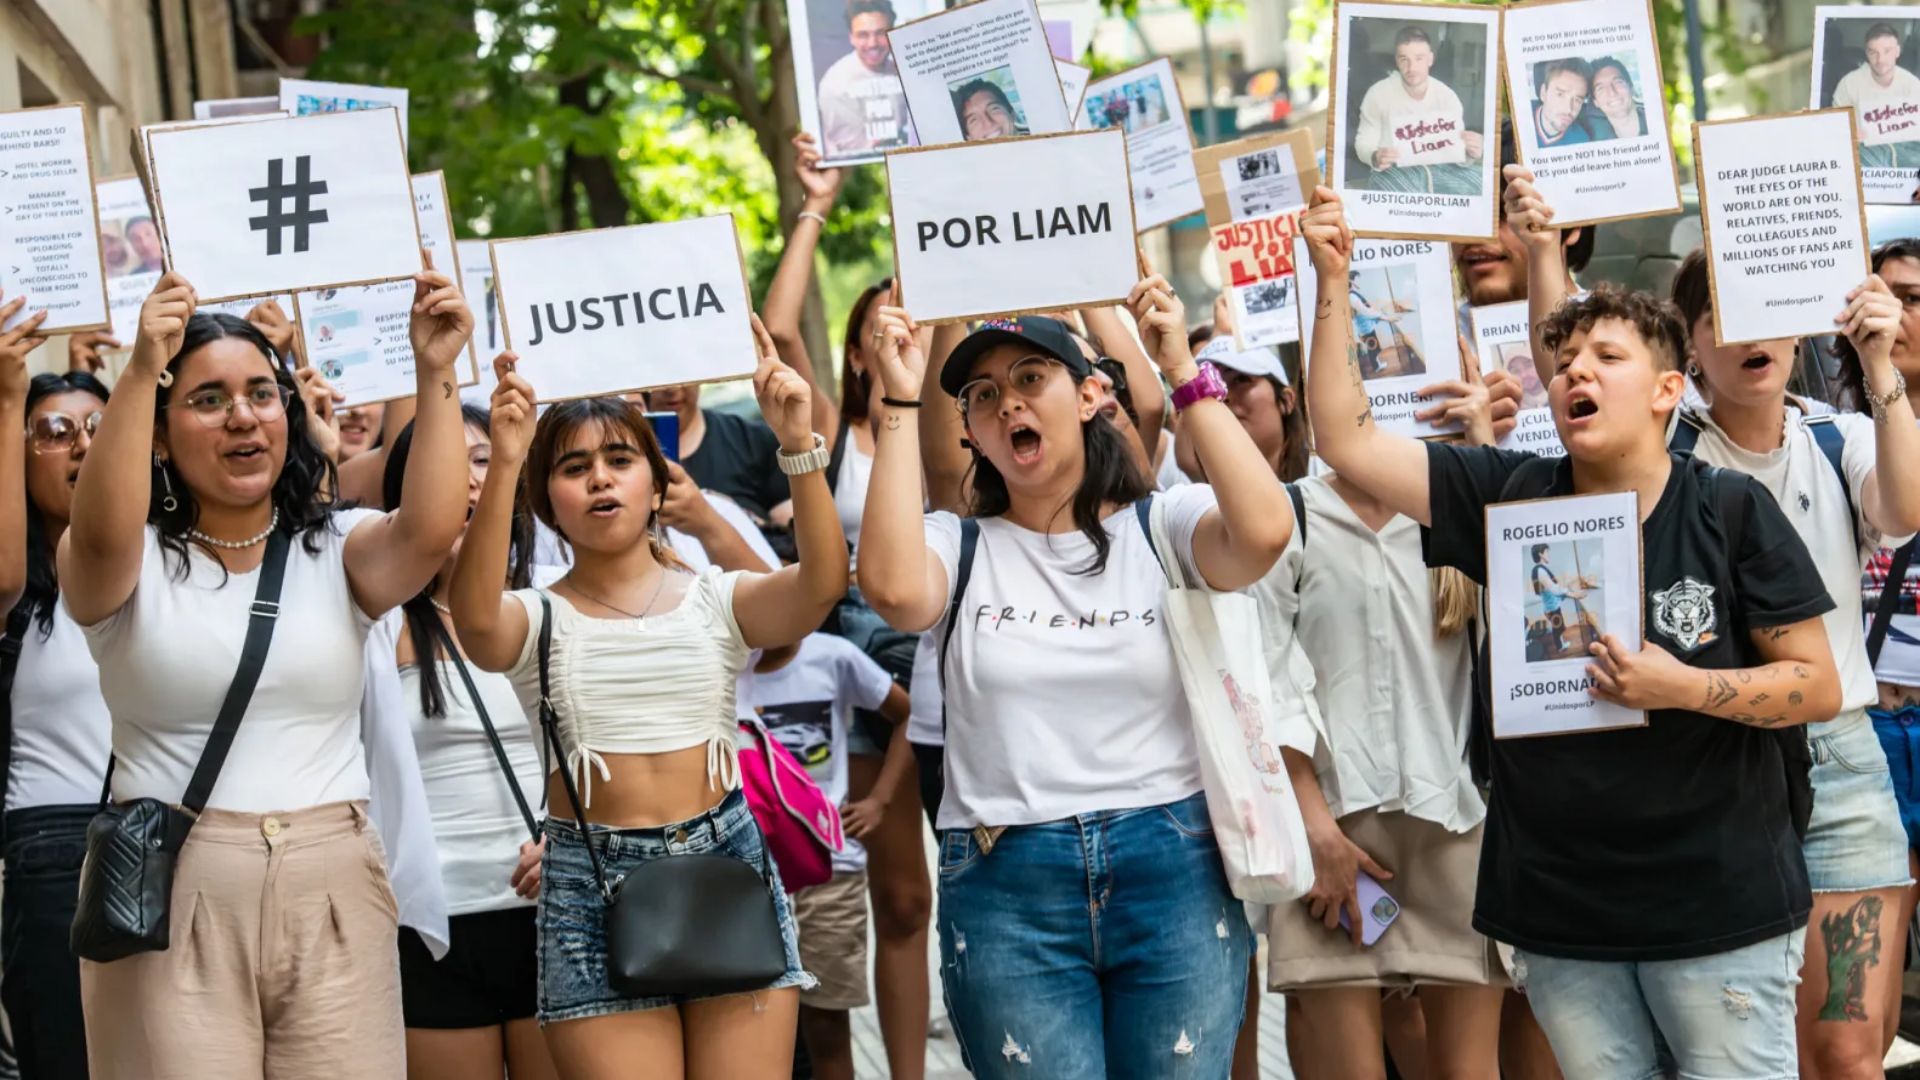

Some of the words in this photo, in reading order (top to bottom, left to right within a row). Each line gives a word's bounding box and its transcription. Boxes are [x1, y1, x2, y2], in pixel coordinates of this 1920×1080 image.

[0, 129, 31, 139] GUILTY
[33, 128, 52, 136] AND
[54, 126, 66, 135] SO
[1411, 139, 1454, 154] Liam
[1531, 157, 1548, 165] You
[1551, 154, 1572, 163] were
[1575, 150, 1594, 160] NOT
[1598, 148, 1611, 156] his
[1613, 144, 1640, 155] friend
[1643, 142, 1659, 151] and
[1533, 169, 1549, 178] YES
[1552, 167, 1568, 177] you
[1570, 163, 1585, 173] did
[1587, 160, 1611, 170] leave
[1614, 158, 1631, 168] him
[1634, 155, 1661, 165] alone!
[1718, 169, 1748, 180] DEAR
[1750, 165, 1786, 180] JUDGE
[1790, 161, 1827, 173] LAURA
[1830, 160, 1841, 169] B.
[28, 190, 66, 199] MANAGER
[1735, 185, 1756, 195] THE
[1759, 182, 1785, 193] EYES
[1788, 180, 1803, 190] OF
[1806, 177, 1828, 188] THE
[249, 156, 328, 256] #
[1361, 193, 1470, 208] #JUSTICIAPORLIAM
[1723, 200, 1765, 213] WORLD
[1769, 198, 1790, 207] ARE
[1793, 196, 1811, 205] ON
[1813, 192, 1842, 203] YOU.
[1727, 214, 1789, 228] RELATIVES,
[1792, 208, 1842, 221] FRIENDS,
[917, 215, 1001, 252] POR
[1012, 202, 1112, 242] LIAM
[1215, 210, 1307, 250] JUSTICI
[1736, 230, 1809, 244] COLLEAGUES
[1811, 225, 1837, 236] AND
[15, 233, 66, 244] RESPONSIBLE
[67, 231, 82, 239] FOR
[26, 243, 73, 253] UPLOADING
[1381, 242, 1432, 258] NORES
[1723, 249, 1778, 262] MILLIONS
[1782, 246, 1796, 256] OF
[1800, 243, 1829, 254] FANS
[1832, 240, 1853, 250] ARE
[32, 253, 70, 262] SOMEONE
[1745, 262, 1808, 275] WATCHING
[1811, 258, 1835, 268] YOU
[19, 273, 76, 285] UNCONSCIOUS
[77, 272, 88, 280] TO
[30, 285, 53, 293] THEIR
[54, 283, 79, 291] ROOM
[1765, 295, 1824, 307] #UnidosporLP
[375, 311, 411, 322] RESPON
[529, 282, 725, 346] JUSTICIA
[1482, 324, 1520, 337] BRIAN
[1503, 522, 1569, 541] ROGELIO
[1574, 516, 1625, 534] NORES
